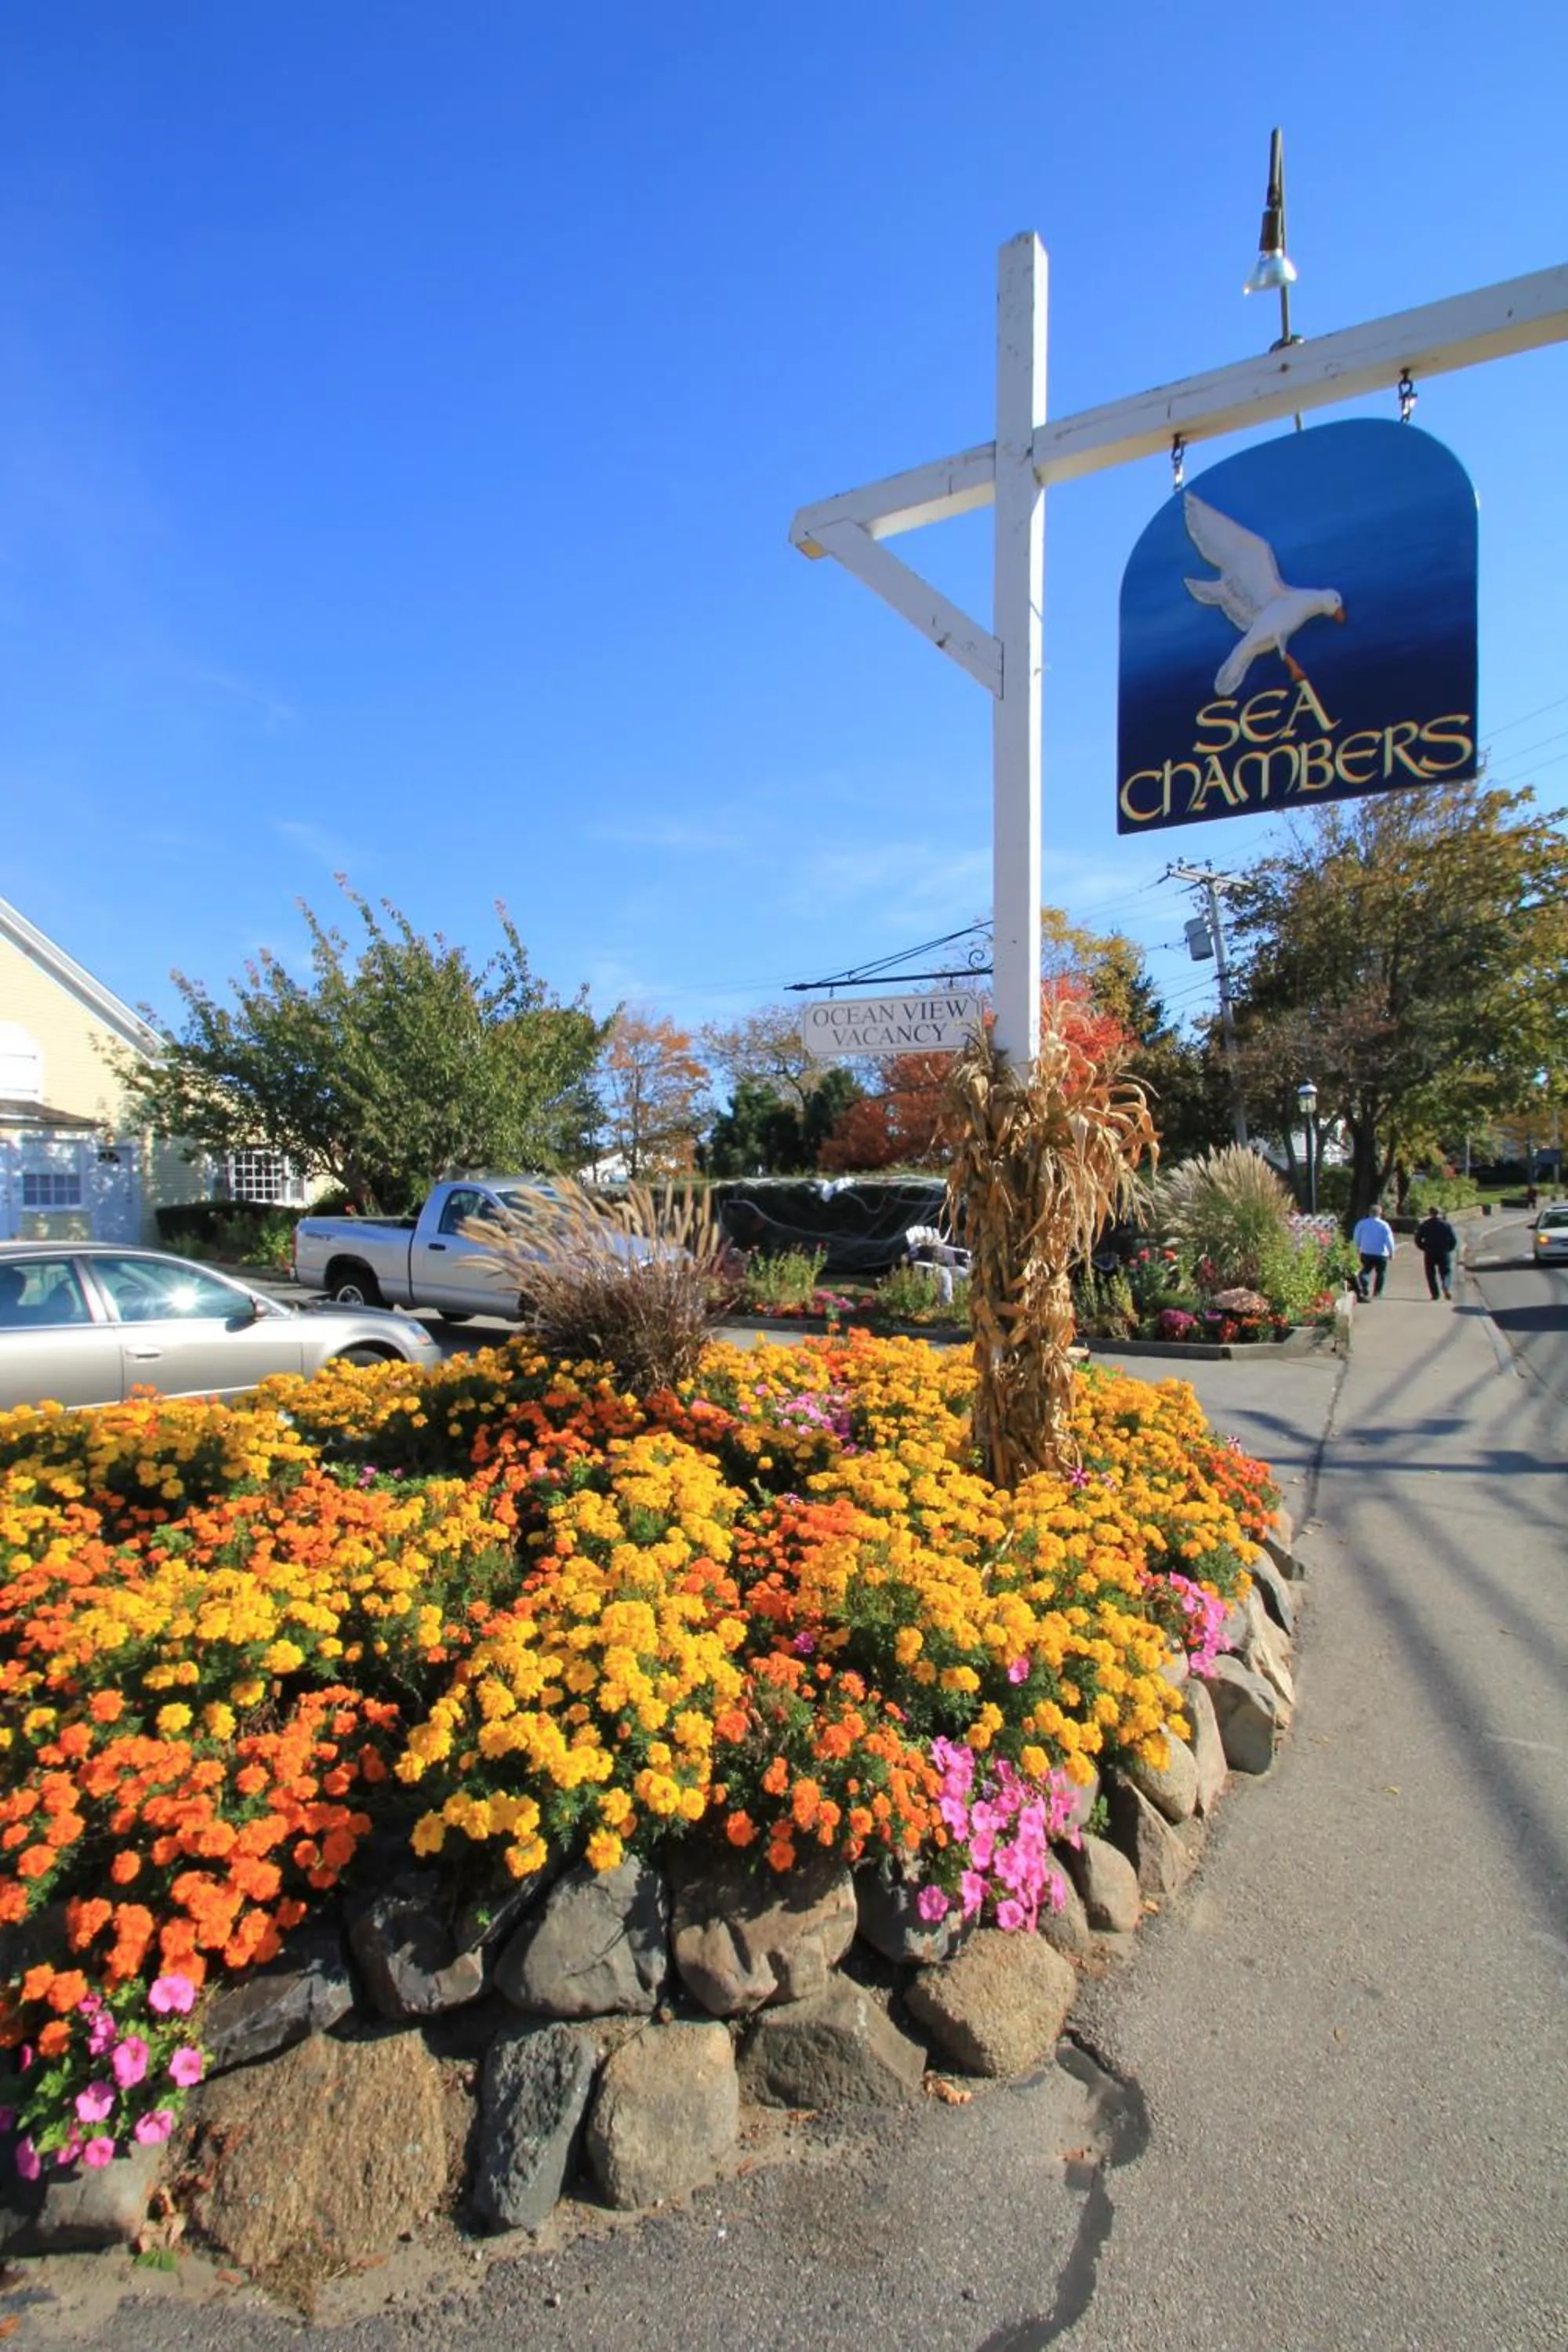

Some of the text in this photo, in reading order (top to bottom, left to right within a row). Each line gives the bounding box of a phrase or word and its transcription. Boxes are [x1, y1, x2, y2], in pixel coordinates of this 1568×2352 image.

[1192, 680, 1341, 753] SEA
[1120, 714, 1474, 822] CHAMBERS
[813, 1000, 968, 1026] OCEAN VIEW
[832, 1023, 946, 1047] VACANCY
